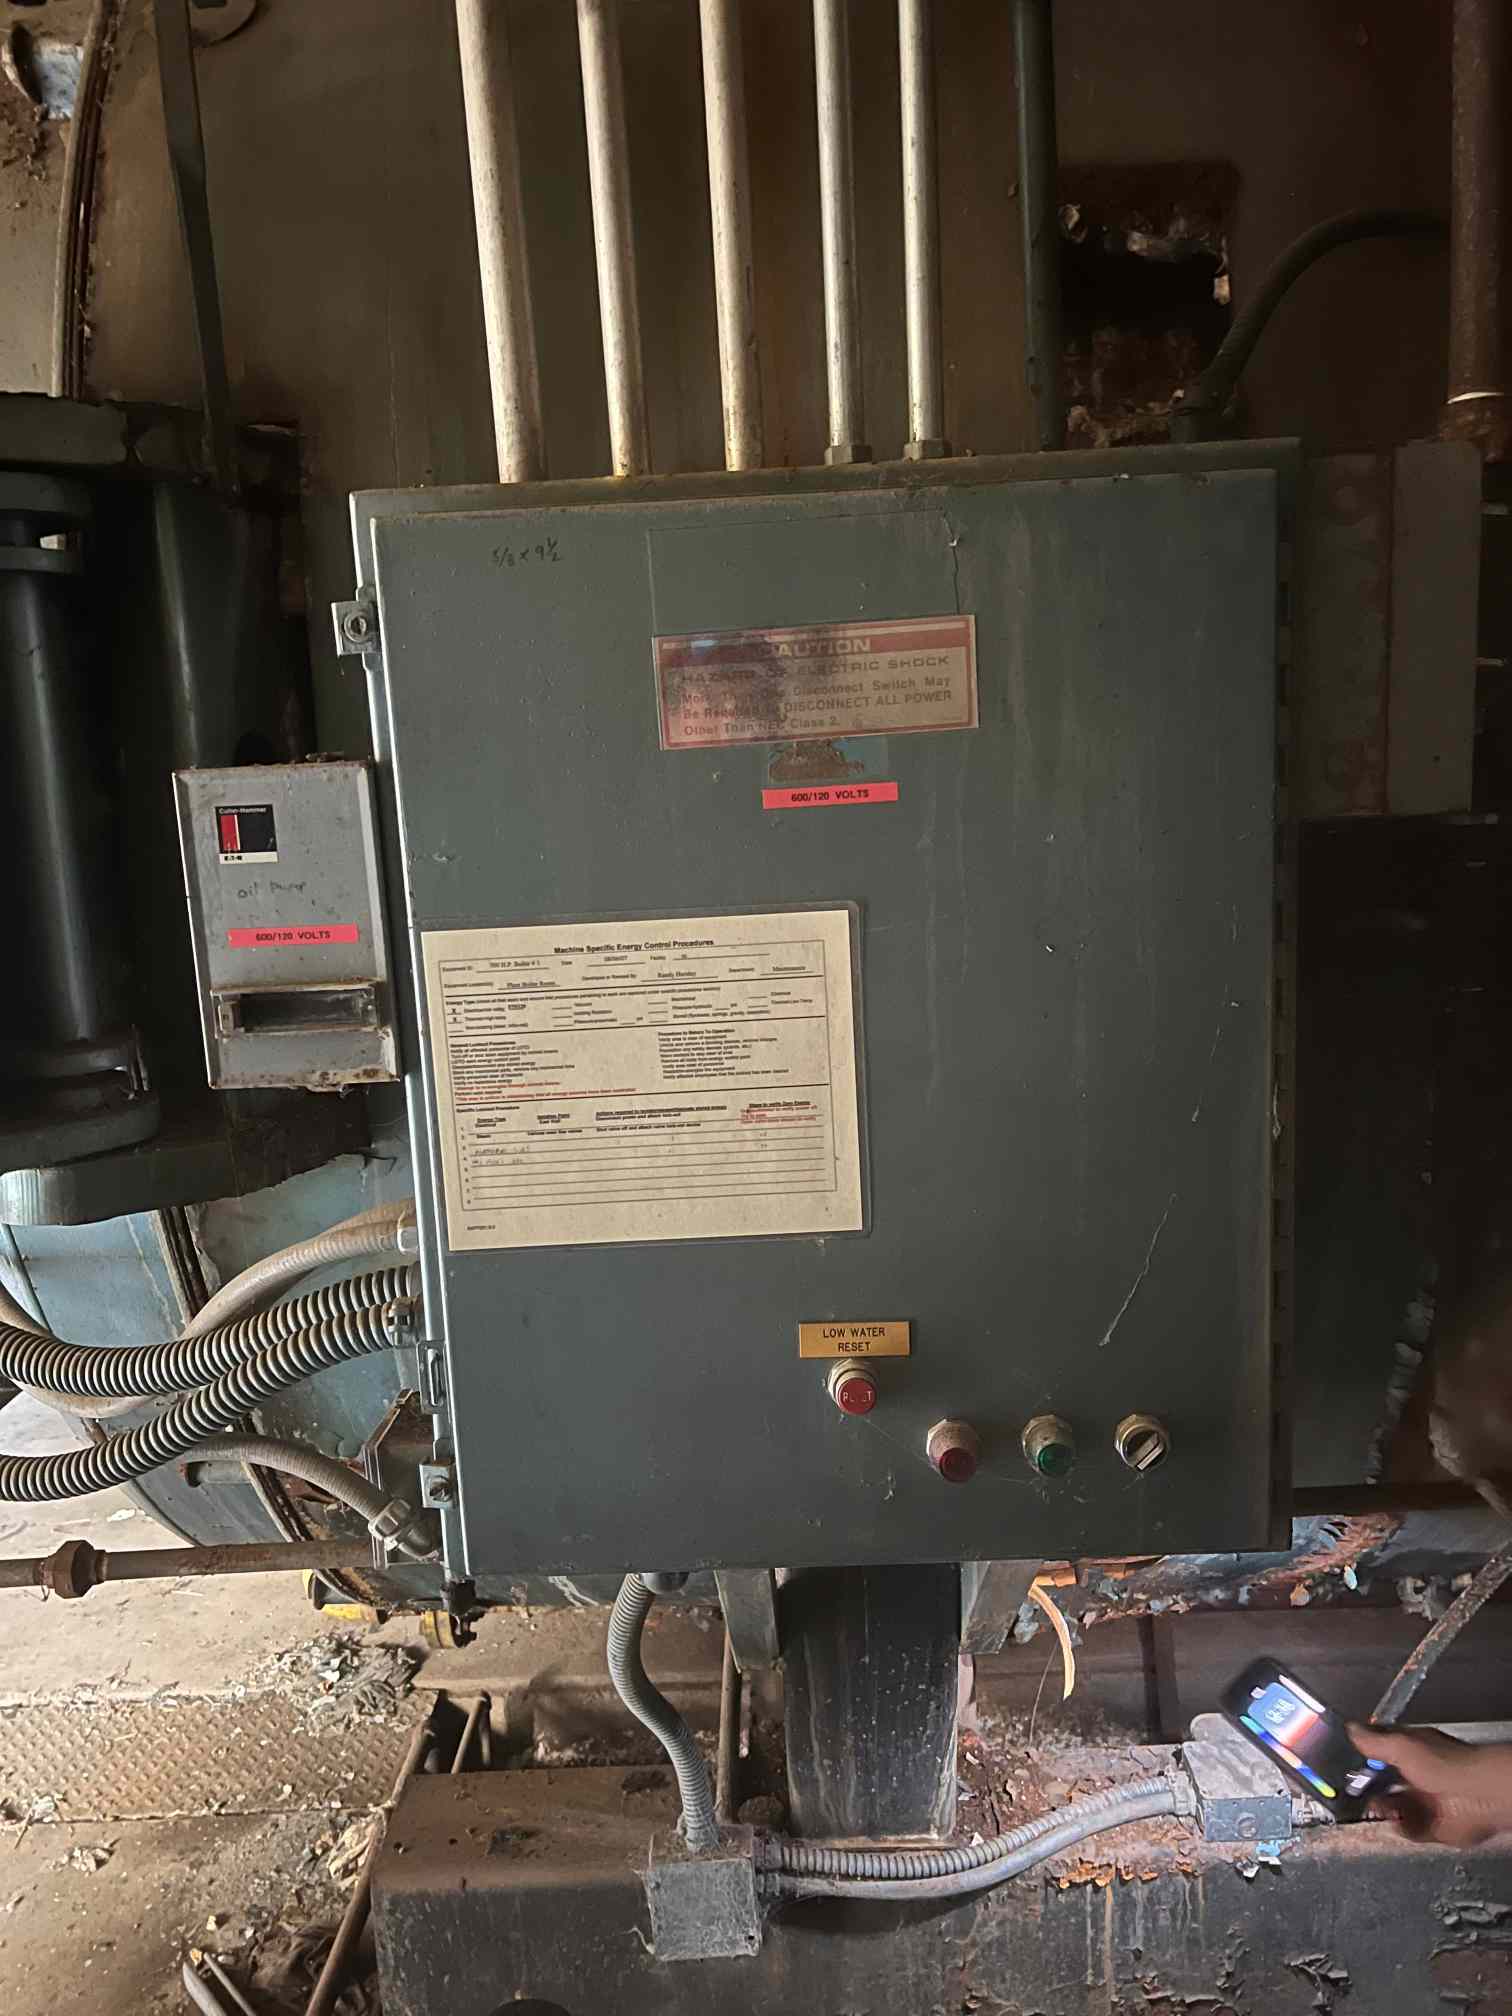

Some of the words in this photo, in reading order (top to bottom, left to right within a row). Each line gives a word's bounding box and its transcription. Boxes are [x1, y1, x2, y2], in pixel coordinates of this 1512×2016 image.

[888, 655, 950, 670] SHOCK
[872, 676, 917, 692] Switch
[924, 675, 951, 690] May
[875, 693, 900, 707] ALL
[903, 689, 952, 705] POWER
[790, 790, 830, 803] 600/120
[834, 788, 870, 800] VOLTS
[255, 931, 294, 942] 600/120
[297, 930, 331, 941] VOLTS
[553, 945, 585, 954] Machine
[586, 943, 616, 954] Specific
[616, 942, 643, 952] Energy
[643, 940, 672, 950] Control
[672, 938, 715, 948] Procedures
[823, 1327, 845, 1339] LOW
[850, 1326, 886, 1338] WATER
[837, 1341, 872, 1353] RESET
